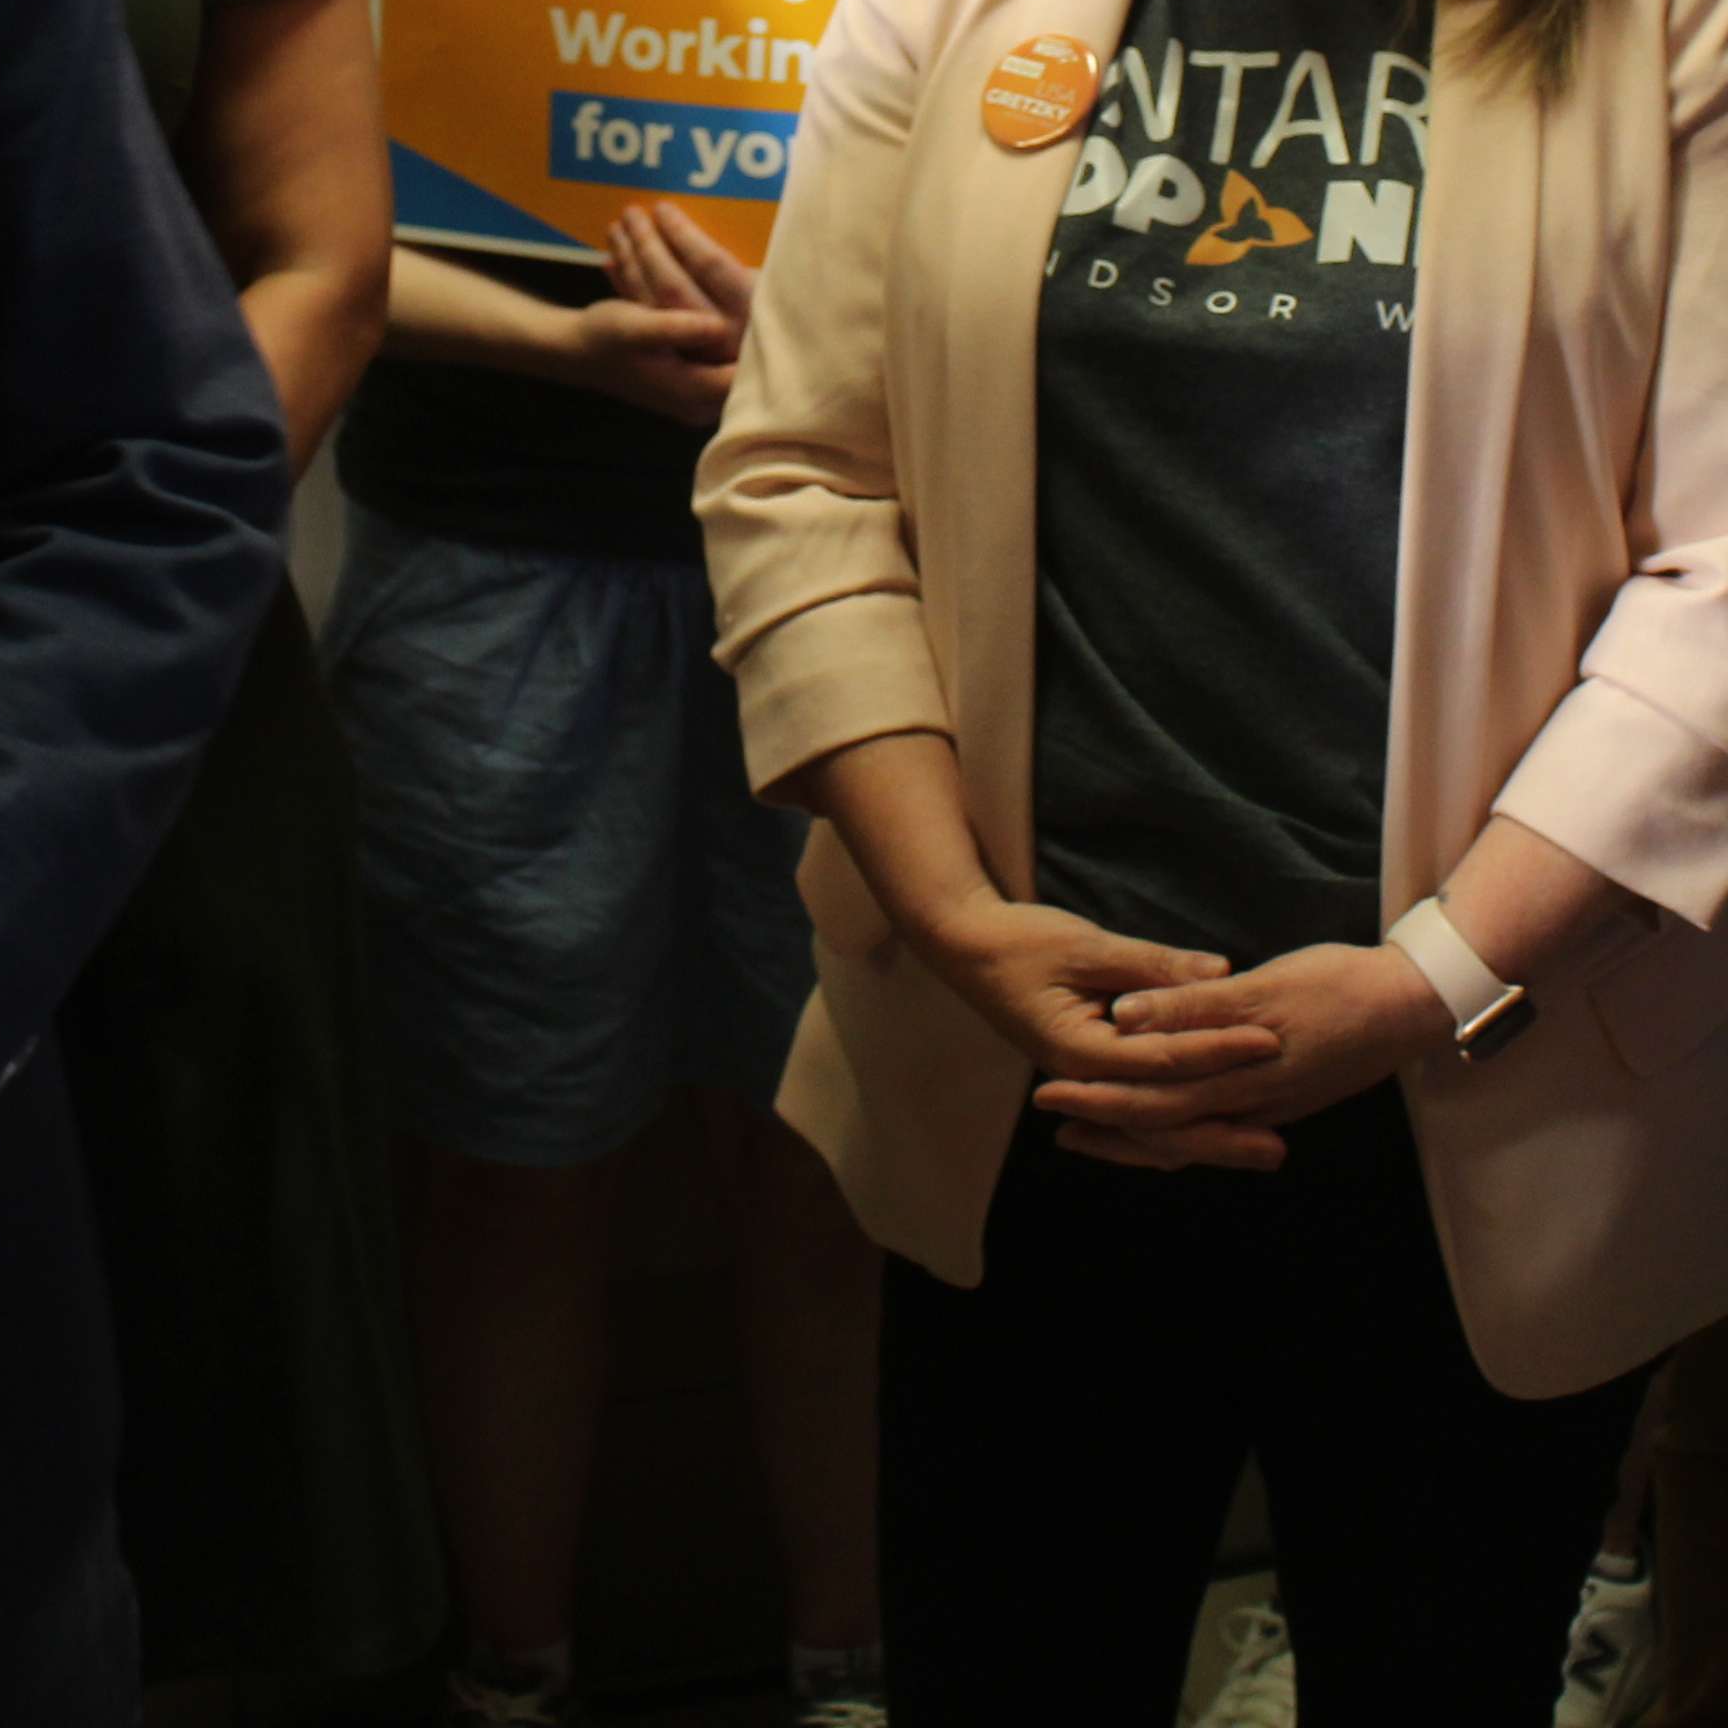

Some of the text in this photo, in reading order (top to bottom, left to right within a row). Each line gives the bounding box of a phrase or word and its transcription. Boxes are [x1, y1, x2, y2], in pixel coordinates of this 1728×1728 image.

[549, 8, 819, 85] Workin
[571, 101, 796, 189] for yo
